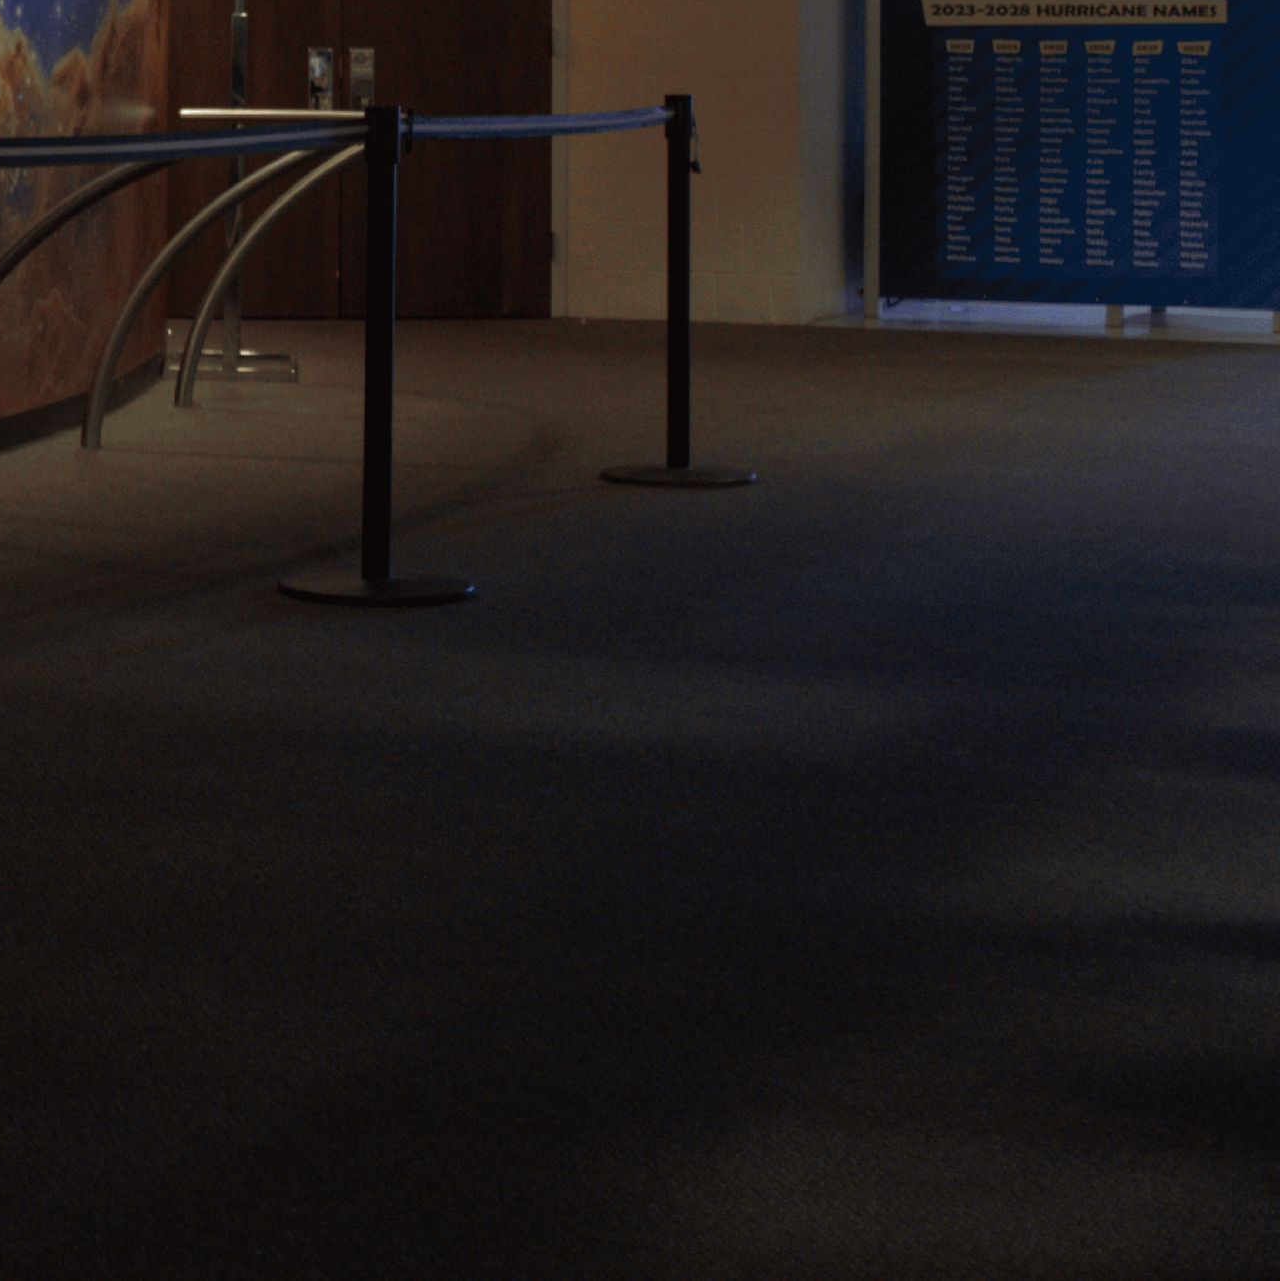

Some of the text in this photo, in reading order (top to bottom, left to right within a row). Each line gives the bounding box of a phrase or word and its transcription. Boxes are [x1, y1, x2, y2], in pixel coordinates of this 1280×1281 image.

[931, 4, 1218, 18] 2023-2028 HURRICANE NAMES
